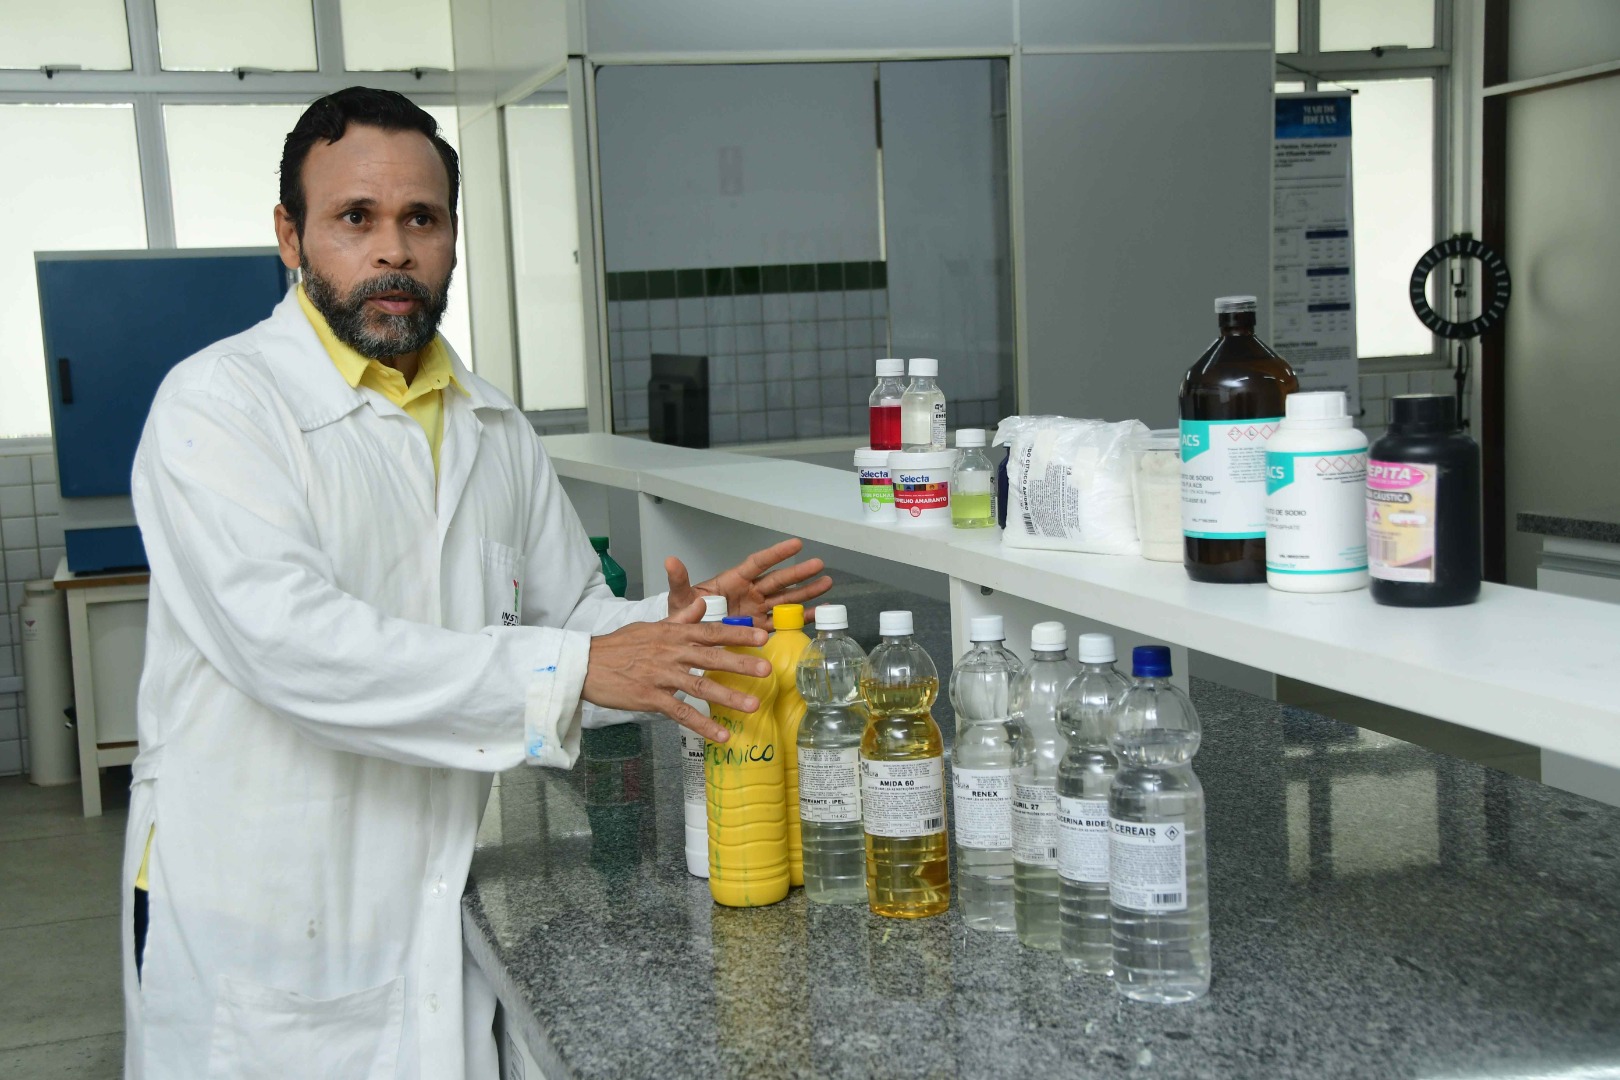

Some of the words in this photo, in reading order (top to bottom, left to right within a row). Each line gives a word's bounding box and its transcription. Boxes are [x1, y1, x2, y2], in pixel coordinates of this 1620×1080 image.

[1183, 434, 1200, 447] ACS
[860, 469, 889, 479] Selecta
[1266, 465, 1285, 479] ACS
[899, 474, 930, 483] Selecta
[914, 496, 947, 504] AMARANTO
[1114, 823, 1156, 837] CEREAIS
